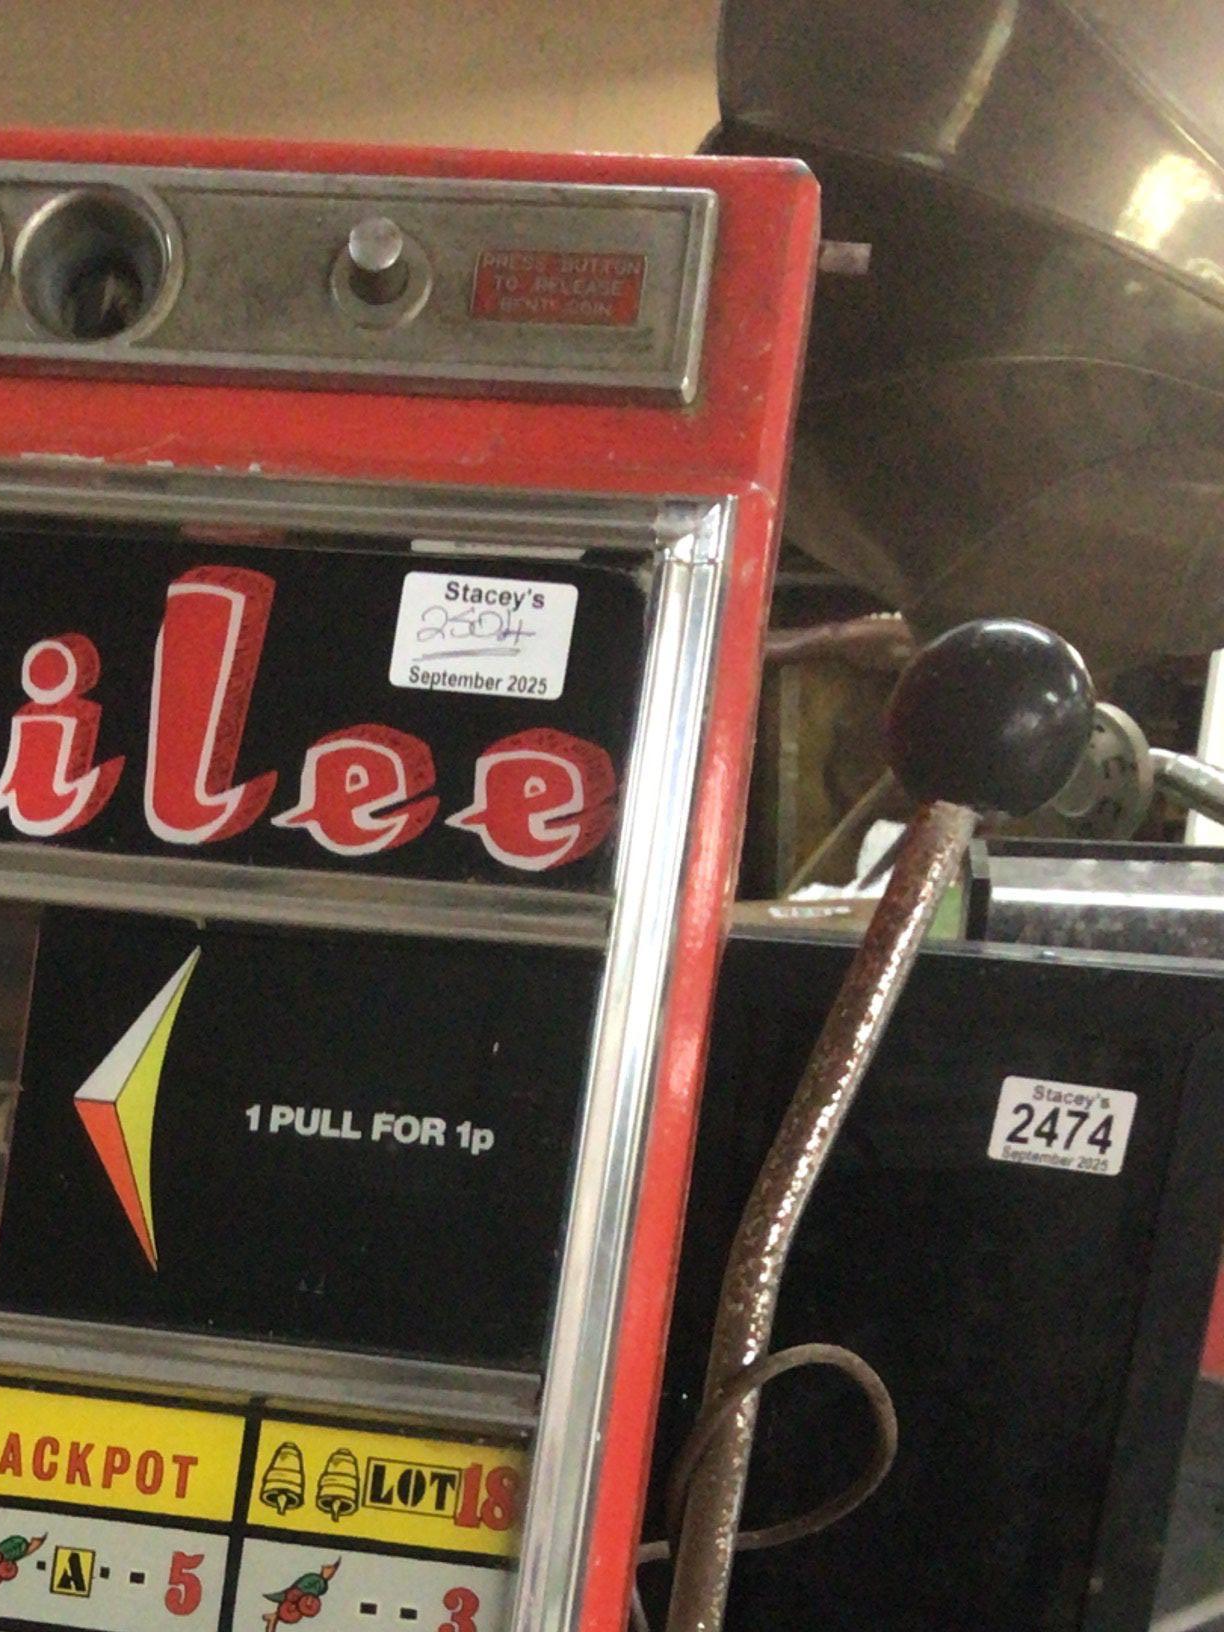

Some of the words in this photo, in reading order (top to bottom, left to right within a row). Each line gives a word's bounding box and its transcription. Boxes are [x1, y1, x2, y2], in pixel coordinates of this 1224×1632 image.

[444, 581, 546, 612] Stacey's
[408, 665, 503, 691] September
[507, 675, 549, 696] 2025
[1032, 1084, 1111, 1110] Stacey's
[245, 1104, 261, 1132] 1
[269, 1104, 362, 1140] PULL
[371, 1111, 447, 1147] FOR
[456, 1120, 495, 1156] 1p
[1006, 1102, 1115, 1155] 2474
[1001, 1145, 1074, 1167] September
[369, 1464, 456, 1511] LOT
[454, 1462, 521, 1532] 18
[56, 1551, 87, 1592] A
[164, 1550, 206, 1617] 5
